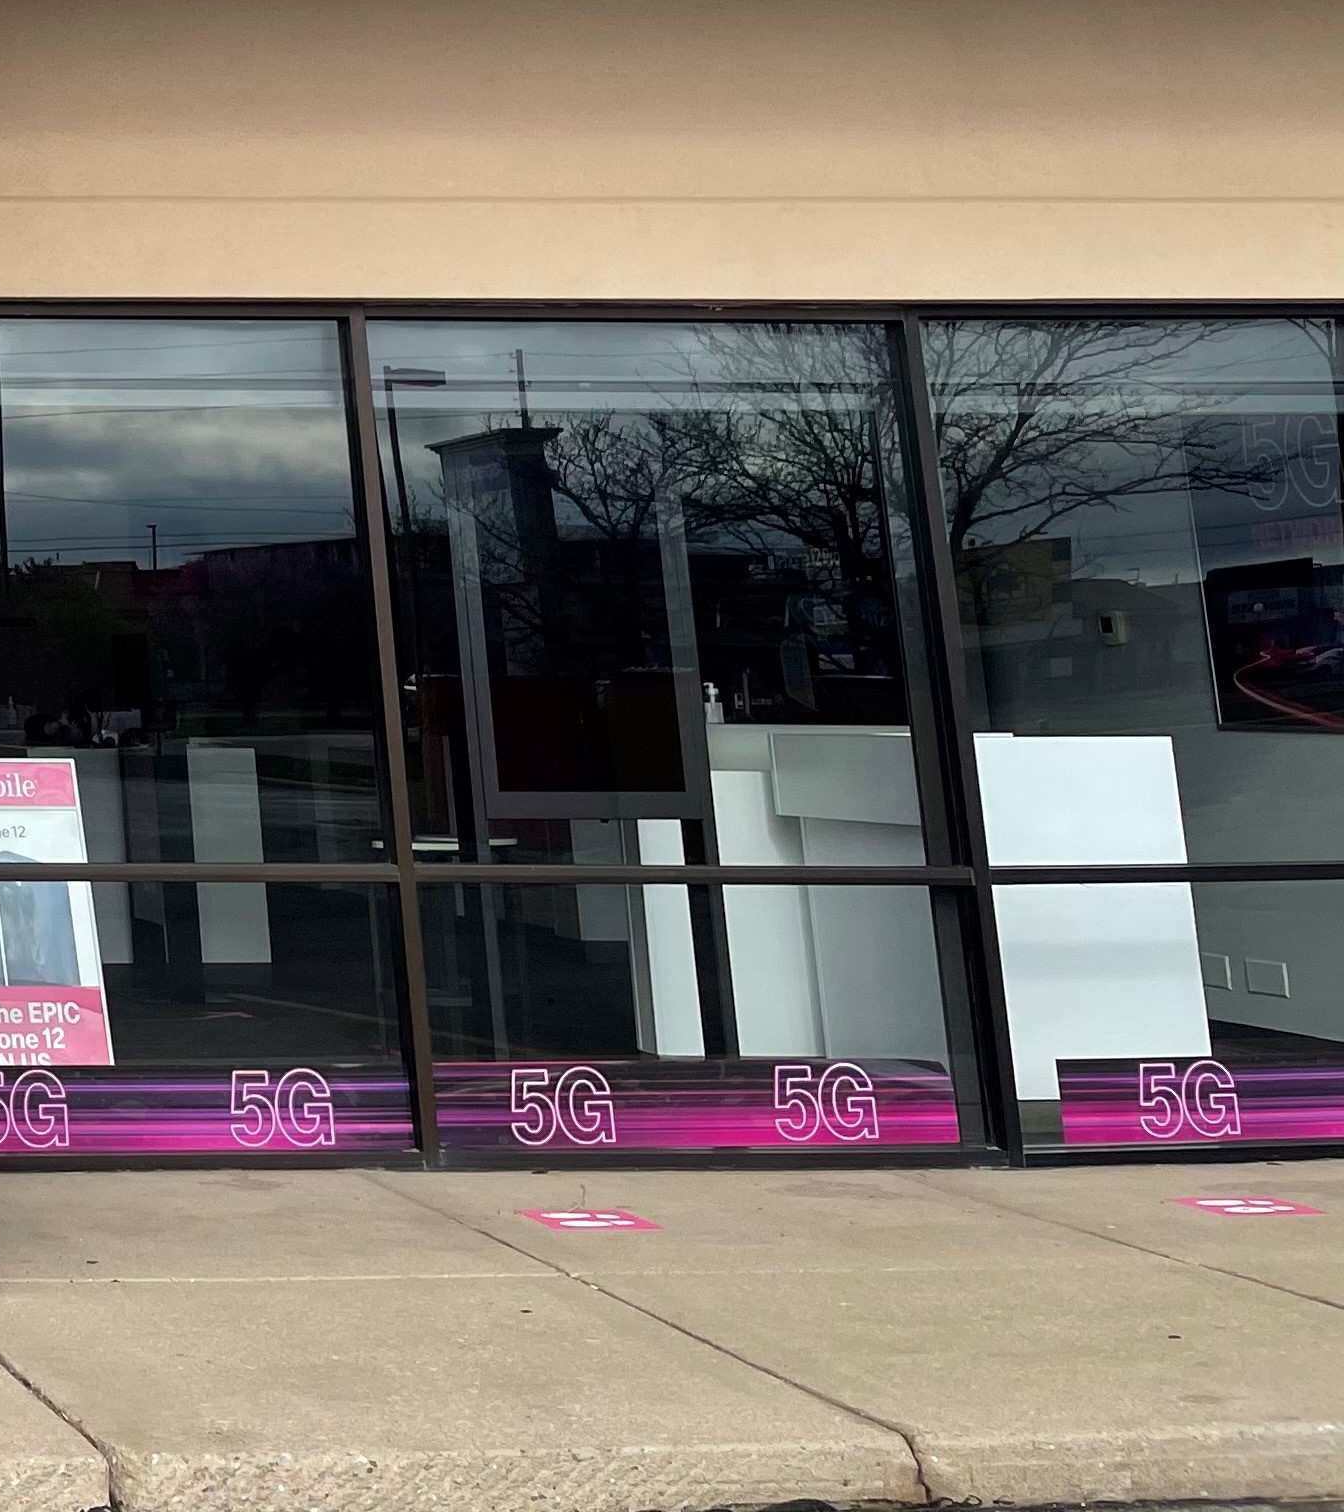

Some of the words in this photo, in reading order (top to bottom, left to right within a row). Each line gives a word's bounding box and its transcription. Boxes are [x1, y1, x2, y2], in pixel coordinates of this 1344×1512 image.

[11, 826, 26, 839] 12
[28, 1001, 81, 1025] EPIC
[42, 1026, 66, 1050] 12
[230, 1067, 335, 1147] 5G
[510, 1065, 617, 1146] 5G
[774, 1062, 880, 1142] 5G
[1138, 1059, 1243, 1139] 5G
